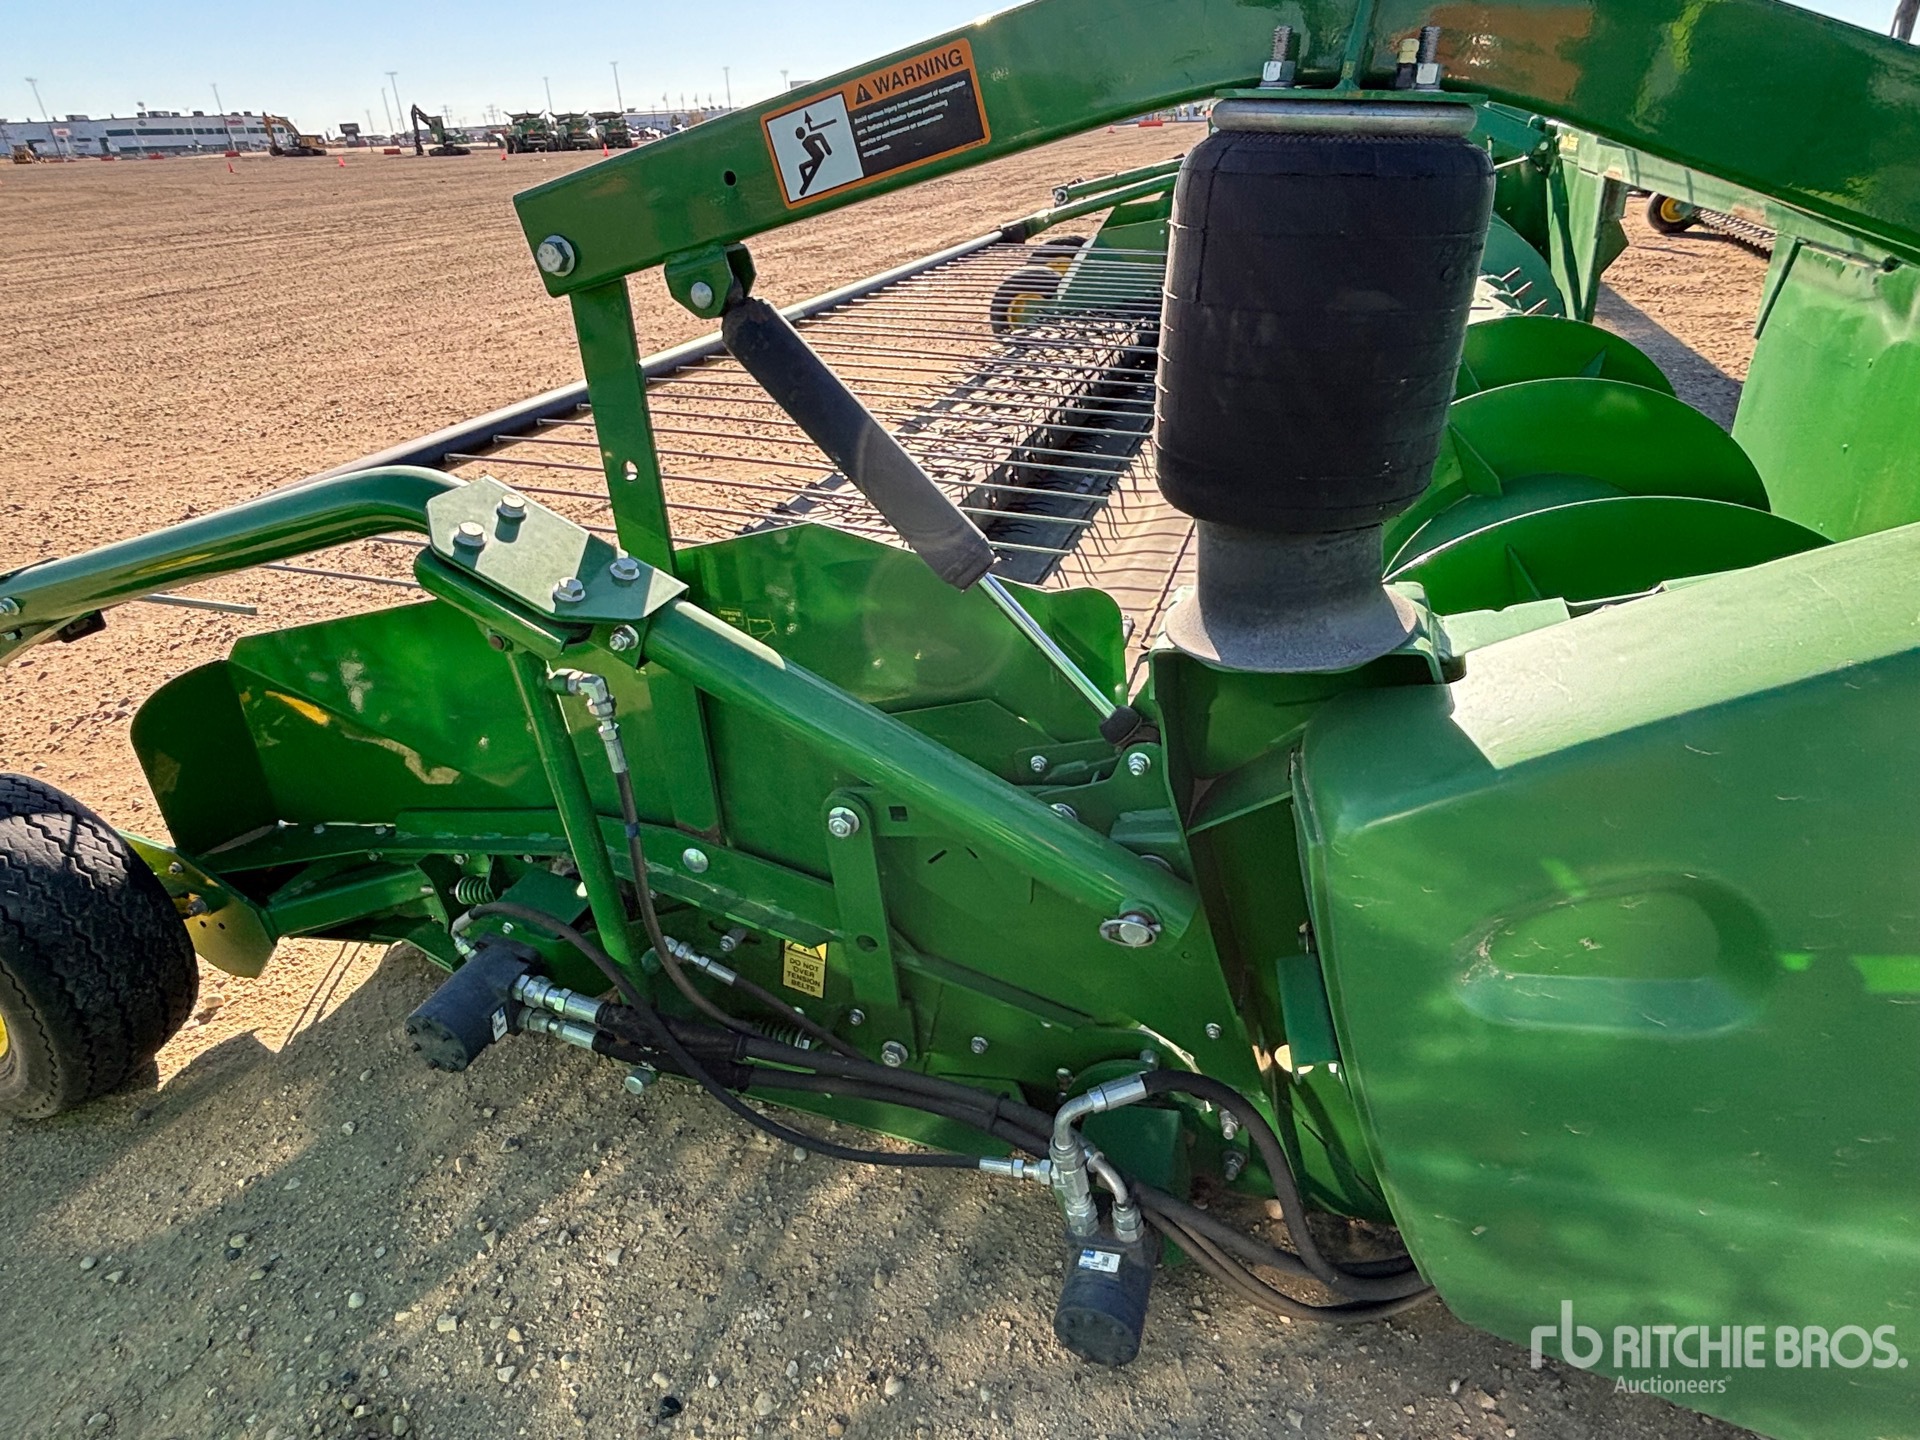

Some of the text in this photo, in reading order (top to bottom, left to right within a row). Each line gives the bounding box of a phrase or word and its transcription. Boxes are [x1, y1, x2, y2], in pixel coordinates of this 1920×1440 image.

[872, 49, 963, 94] WARNING
[897, 101, 909, 109] from
[906, 108, 923, 119] before
[922, 99, 949, 114] performing
[790, 958, 819, 972] DO NOT
[793, 966, 815, 978] OVER
[787, 971, 820, 987] TENSION
[791, 979, 815, 992] BELTS
